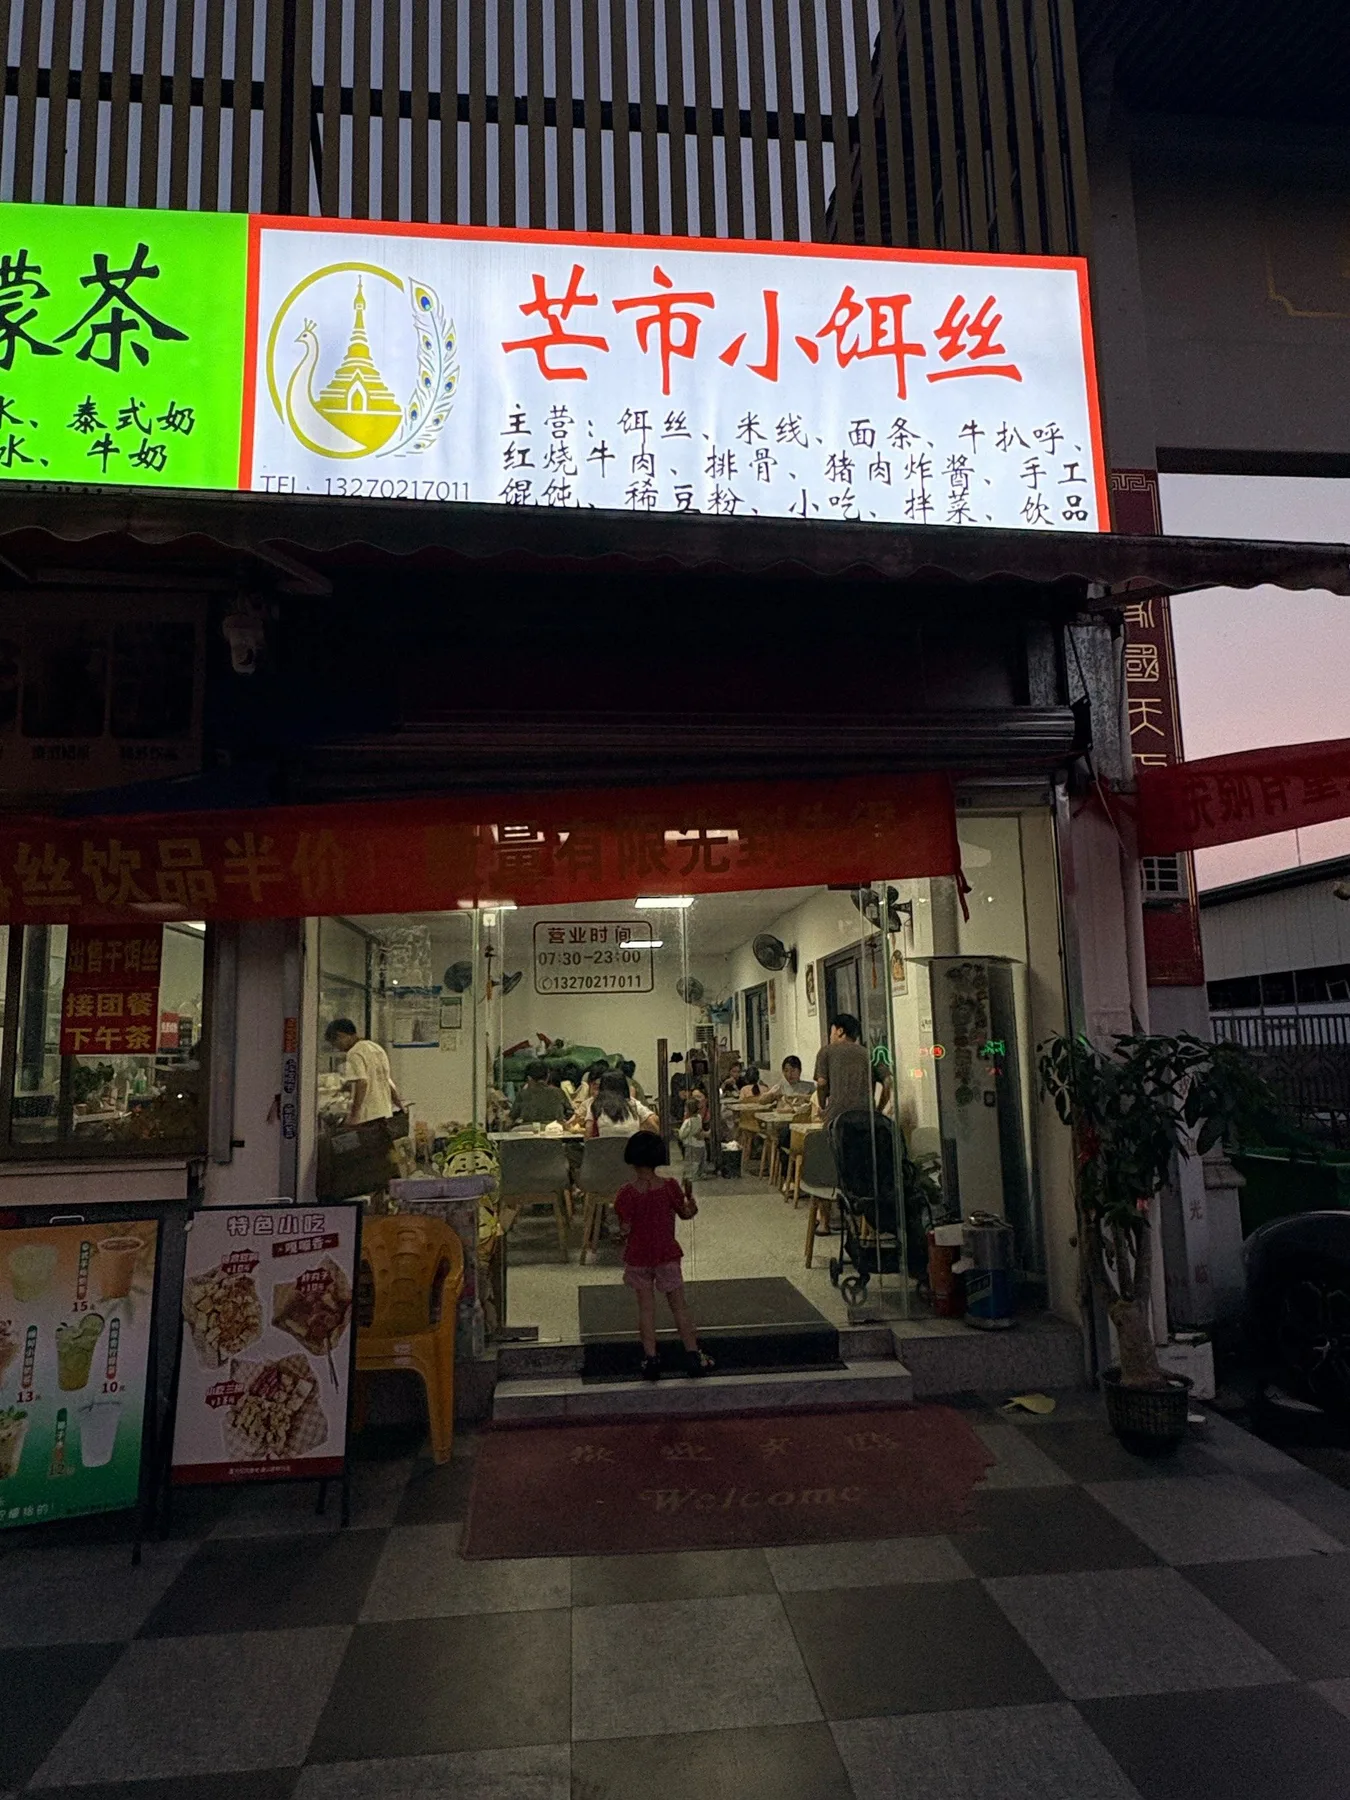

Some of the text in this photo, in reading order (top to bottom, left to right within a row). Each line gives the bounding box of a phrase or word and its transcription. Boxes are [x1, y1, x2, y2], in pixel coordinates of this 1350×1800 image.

[502, 264, 1024, 402] 芒市小饵丝
[325, 477, 469, 502] 13270217011
[0, 828, 348, 909] 丝饮品半价
[547, 926, 632, 944] 营业时间
[554, 975, 641, 990] 13270217011
[66, 991, 153, 1018] 接团餐
[65, 1025, 153, 1051] 下午茶
[227, 1214, 325, 1236] 特色小吃
[640, 1484, 864, 1513] Welcome
